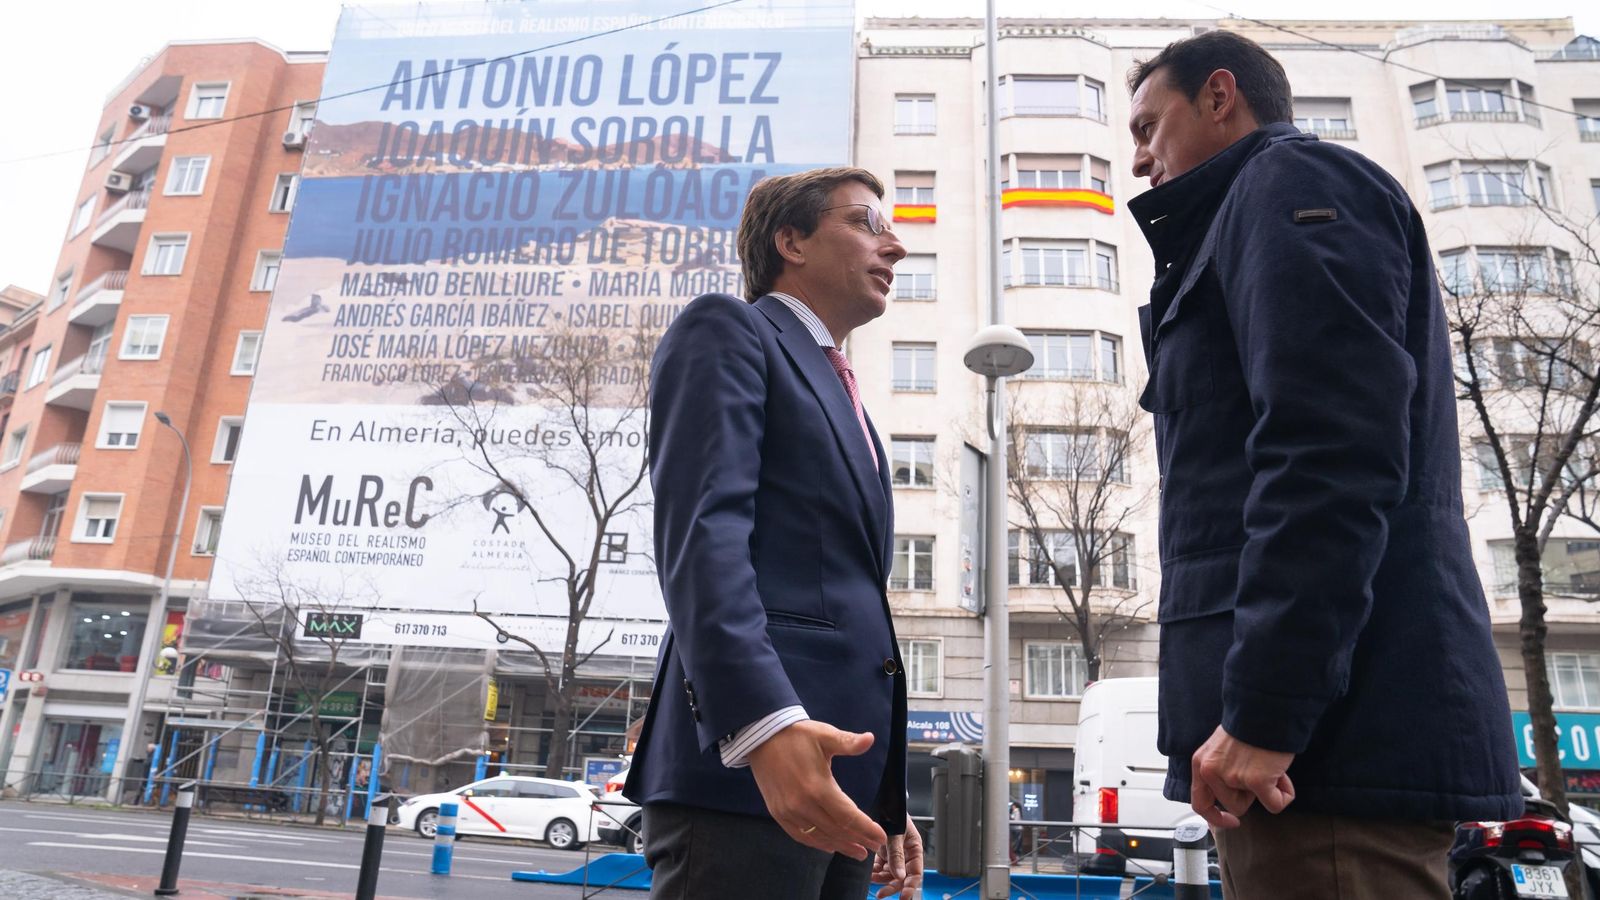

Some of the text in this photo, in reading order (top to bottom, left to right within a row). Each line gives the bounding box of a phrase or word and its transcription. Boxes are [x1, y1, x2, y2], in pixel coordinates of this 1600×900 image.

[518, 16, 590, 33] REALISMO
[380, 42, 783, 111] ANTONIO LÓPEZ
[370, 107, 776, 168] JOAQUÍN SOROLLA
[355, 168, 766, 223] IGNACIO ZULOAG
[347, 228, 433, 266] JULIO
[439, 227, 577, 265] ROMERO
[584, 227, 628, 264] DE
[340, 271, 437, 297] MARIANO
[445, 270, 564, 297] BENLLIURE
[590, 264, 662, 297] MARÍA
[333, 299, 406, 328] ANDRÉS
[410, 297, 475, 328] GARCÍA
[481, 296, 548, 328] IBÁÑEZ
[568, 304, 633, 328] ISABEL
[328, 330, 373, 359] JOSÉ
[376, 328, 438, 359] MARÍA
[444, 328, 505, 360] LÓPEZ
[322, 362, 407, 384] FRANCISCO
[411, 360, 461, 384] LÓPEZ
[576, 366, 643, 386] ARADA
[310, 419, 341, 442] En
[349, 420, 463, 448] Almería,
[473, 426, 572, 450] puedes
[294, 474, 434, 530] MuReC
[290, 532, 427, 551] MUSEO DEL REALISMO
[288, 548, 424, 568] ESPAÑOL CONTEMPORÁNEO
[310, 620, 356, 634] MAX
[395, 623, 447, 637] 617 370 713
[620, 633, 658, 647] 617 370
[1523, 723, 1600, 762] EO
[1524, 867, 1560, 881] 8361
[1529, 881, 1556, 894] JYX
